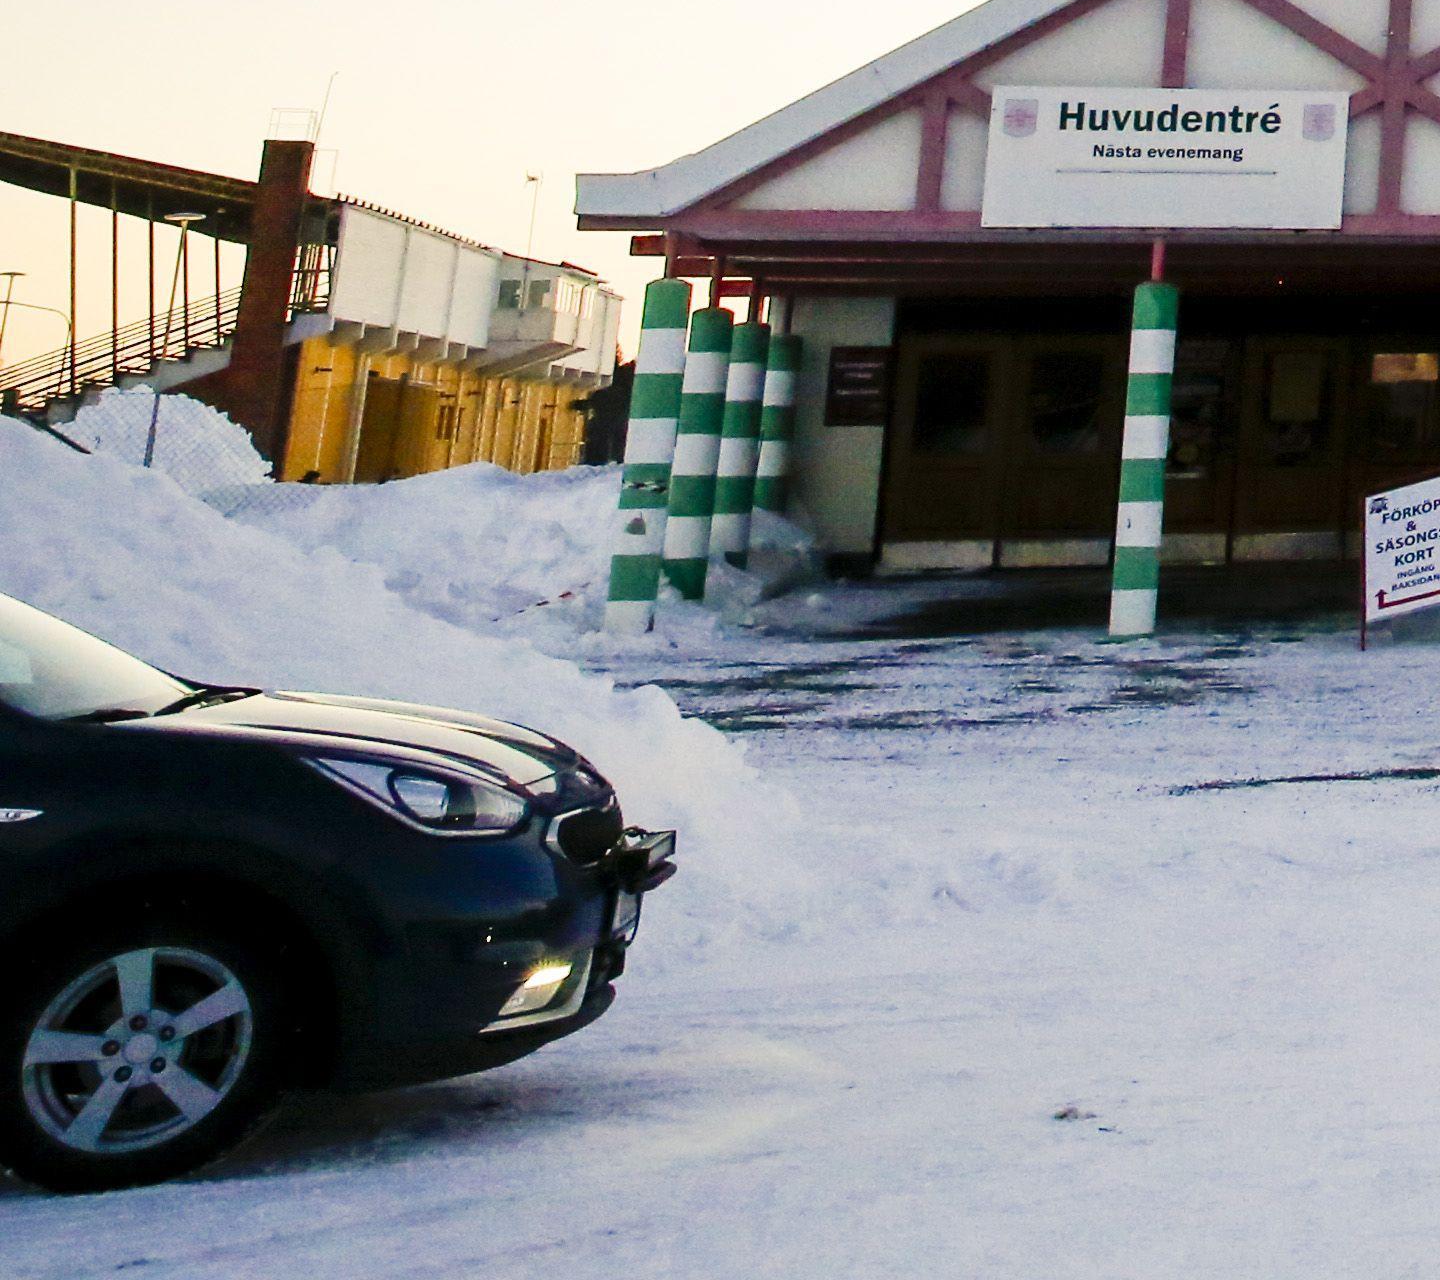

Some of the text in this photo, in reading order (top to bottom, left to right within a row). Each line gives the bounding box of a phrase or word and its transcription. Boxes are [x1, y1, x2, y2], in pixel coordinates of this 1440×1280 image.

[1058, 101, 1282, 135] Huvudentré
[1092, 143, 1244, 163] Nästa evenemang
[1406, 521, 1417, 532] &
[1394, 547, 1435, 567] KORT
[1397, 564, 1435, 579] INGÅNG
[1391, 574, 1440, 591] BAKSIDAN
